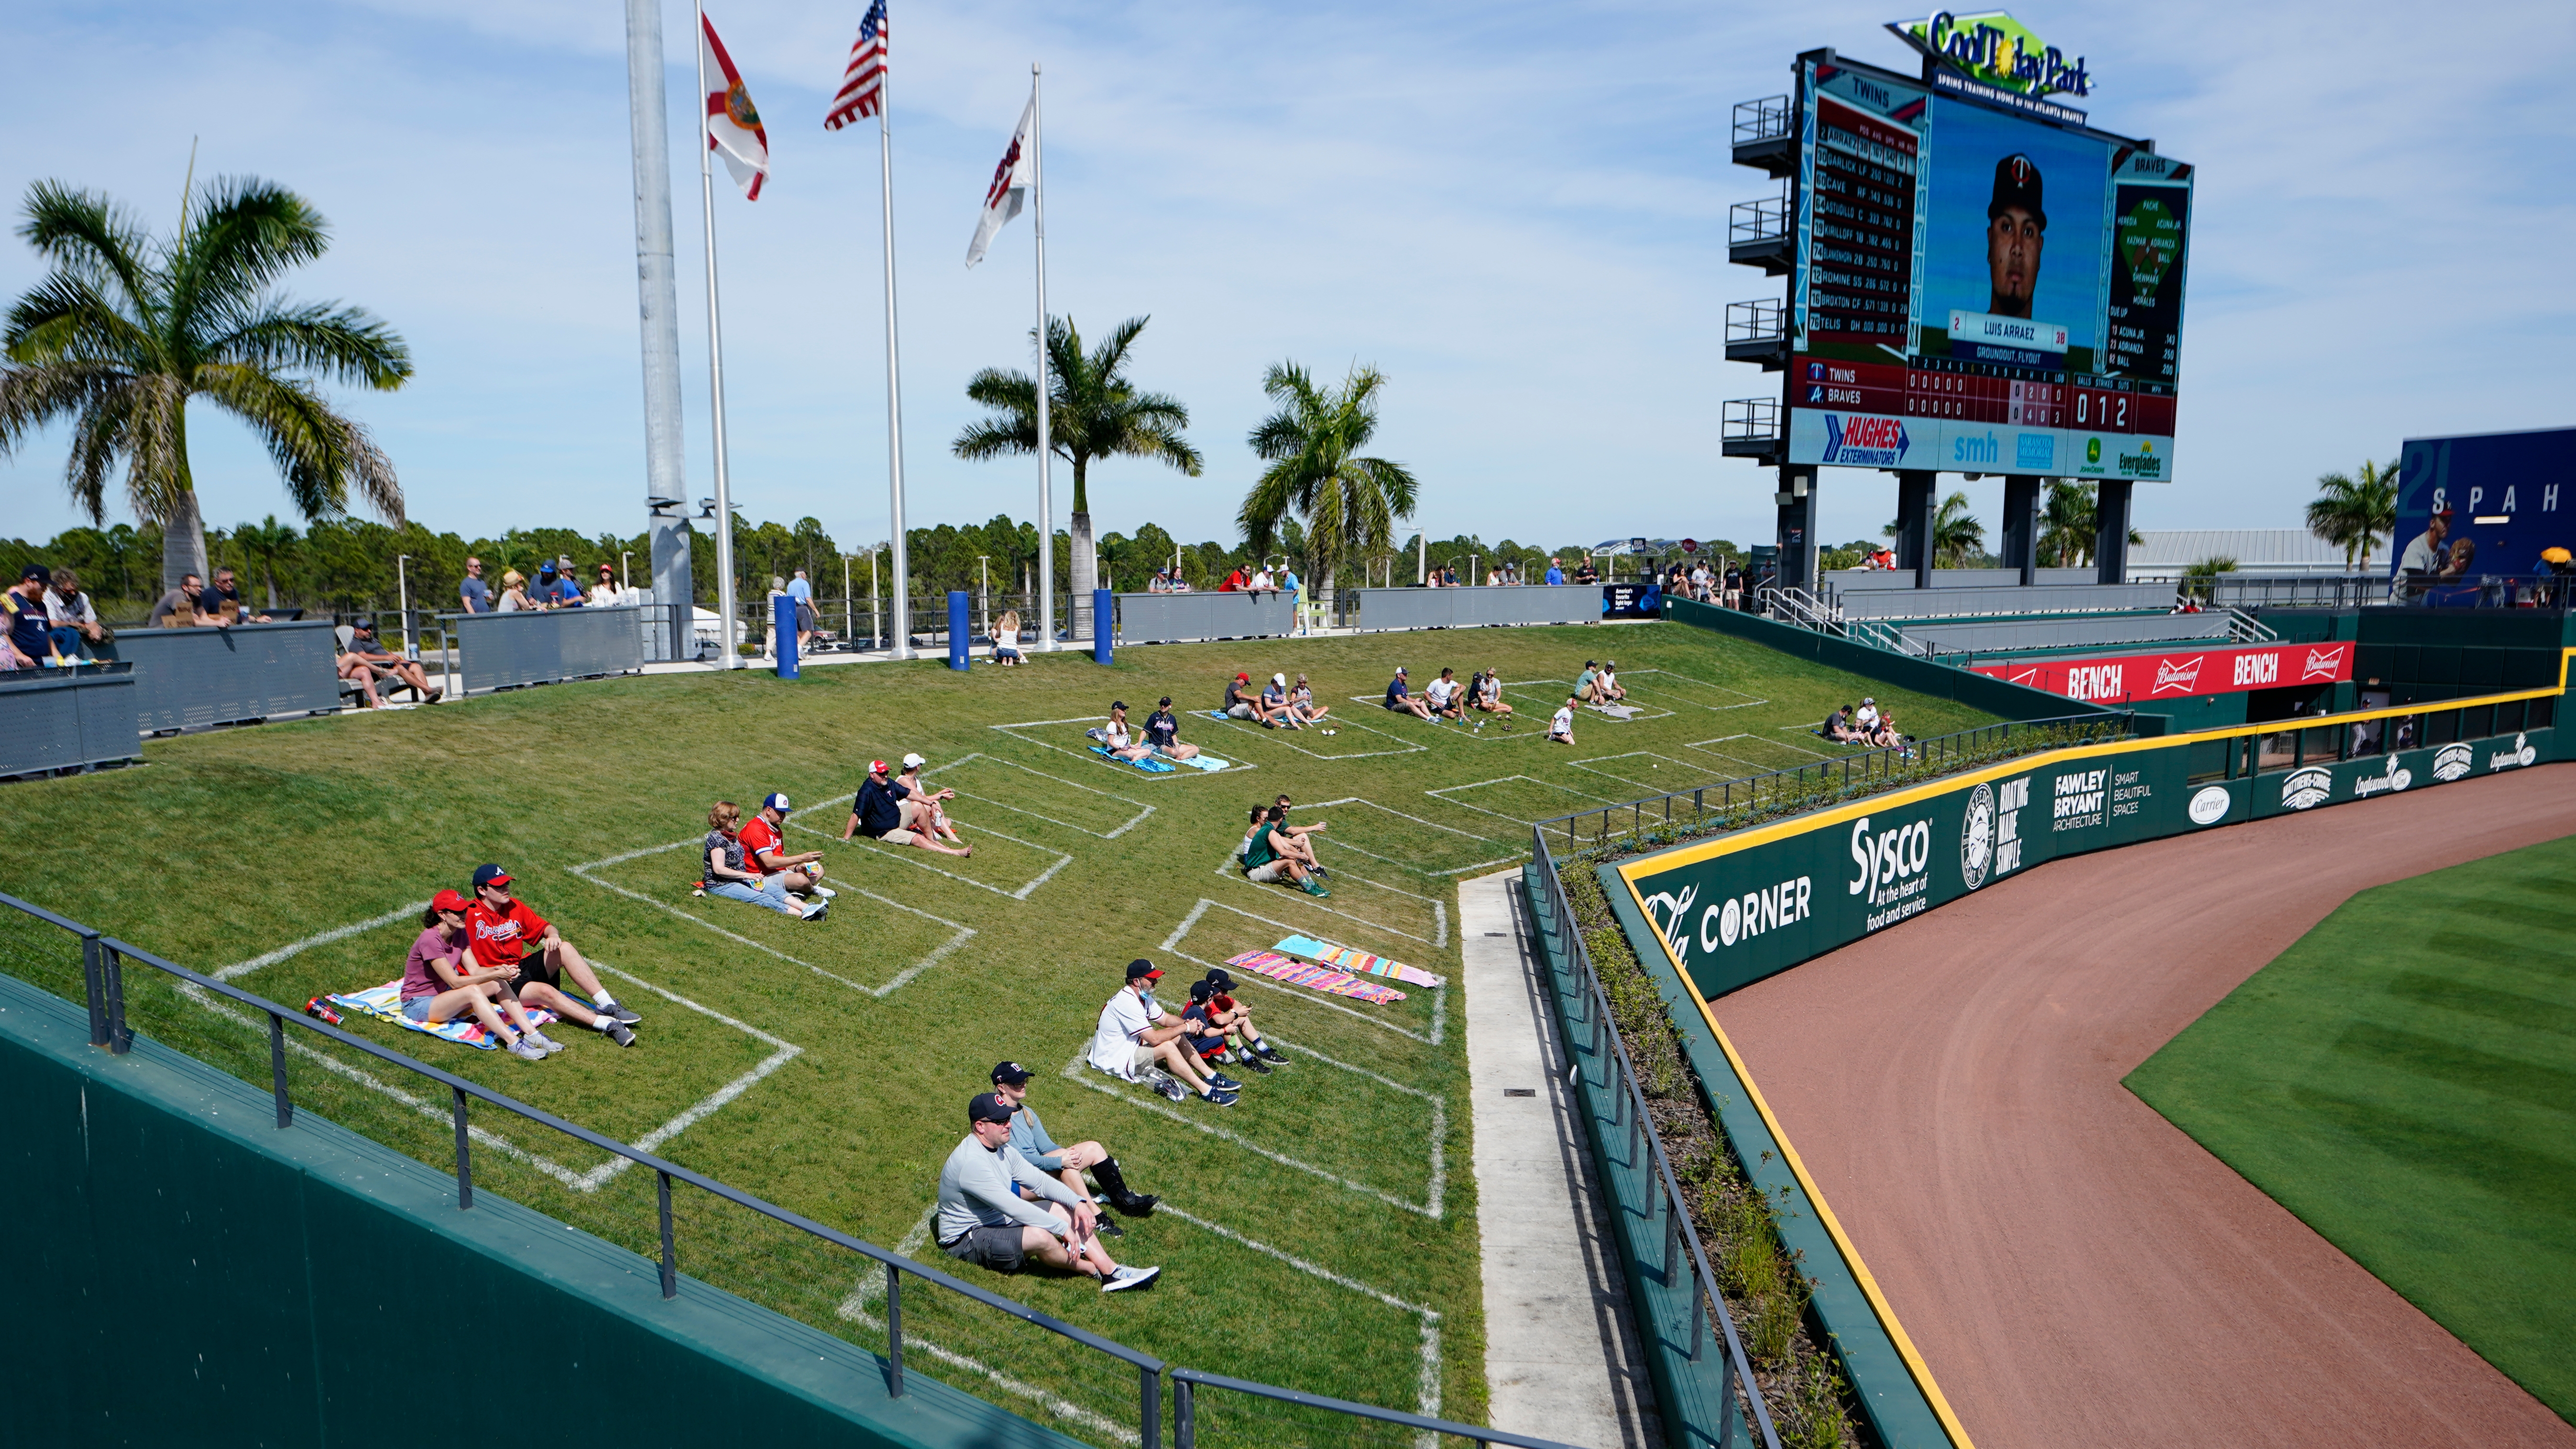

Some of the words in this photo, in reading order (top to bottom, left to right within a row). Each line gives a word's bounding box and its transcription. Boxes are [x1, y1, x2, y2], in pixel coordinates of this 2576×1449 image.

[2040, 43, 2089, 98] Park
[1853, 76, 1889, 109] TWINS
[1938, 73, 1962, 90] SPRING
[1964, 80, 1994, 99] TRAINING
[1996, 89, 2014, 105] HOME
[2016, 97, 2023, 108] OF
[2024, 99, 2034, 110] THE
[2035, 101, 2061, 118] ATLANTA
[2062, 109, 2083, 124] BRAVES
[1828, 128, 1857, 150] ARRAEZ
[1828, 153, 1856, 174] GARLICK
[2135, 156, 2166, 173] BRAVES
[1827, 176, 1846, 194] CAVE
[1826, 200, 1854, 219] ASTUDILLO
[1859, 209, 1863, 221] C
[1896, 219, 1901, 231] 0
[2143, 199, 2159, 212] PACHE
[2117, 215, 2137, 227] HEREDIA
[2156, 219, 2173, 231] ACUNA
[1825, 223, 1853, 241] KIRILLOFF
[1895, 240, 1899, 252] 0
[2127, 235, 2147, 247] KAZMAR
[2150, 237, 2175, 250] ADRIANZA
[1894, 260, 1898, 272] 0
[2158, 252, 2170, 263] BALL
[1823, 270, 1851, 286] ROMINE
[1853, 275, 1862, 288] SS
[1893, 281, 1897, 293] 0
[1903, 283, 1907, 294] K
[2132, 272, 2159, 285] SHEWMAKE
[1821, 294, 1850, 308] BROXTON
[1852, 297, 1861, 309] CF
[1892, 302, 1896, 314] 0
[2133, 295, 2156, 307] MORALES
[2110, 305, 2120, 318] DUE
[2120, 307, 2128, 318] UP
[1821, 317, 1841, 330] TELIS
[1851, 319, 1860, 332] DH
[1862, 320, 1874, 332] .000
[1875, 321, 1887, 333] .000
[1891, 323, 1895, 334] 0
[1954, 317, 1960, 330] 2
[1984, 321, 2002, 336] LUIS
[2004, 325, 2035, 341] ARRAEZ
[2112, 324, 2117, 336] 13
[2119, 326, 2136, 339] ACUNA
[2056, 331, 2065, 344] 3B
[1977, 346, 2017, 363] GROUNDOUT,
[2018, 351, 2041, 365] FLYOUT
[2110, 339, 2116, 350] 23
[2117, 340, 2144, 355] ADRIANZA
[2162, 348, 2174, 361] .250
[1913, 357, 1916, 367] 1
[1924, 358, 1928, 369] 2
[1936, 359, 1940, 370] 3
[1948, 361, 1951, 371] 4
[1983, 364, 1986, 375] 7
[2117, 354, 2129, 368] BALL
[2161, 363, 2173, 376] .200
[1830, 367, 1855, 384] TWINS
[1910, 373, 1916, 387] 0
[1922, 375, 1928, 389] 0
[1934, 376, 1940, 390] 0
[1946, 377, 1951, 391] 0
[1958, 379, 1963, 392] 0
[2015, 384, 2020, 397] 0
[2028, 386, 2034, 399] 2
[2042, 387, 2047, 400] 0
[2057, 389, 2061, 401] 0
[2078, 375, 2091, 386] BALLS
[2095, 378, 2113, 389] STRIKES
[2118, 380, 2129, 390] OUTS
[2152, 384, 2161, 394] MPH
[1828, 388, 1861, 405] BRAVES
[1909, 398, 1914, 412] 0
[1921, 399, 1927, 413] 0
[1933, 400, 1939, 414] 0
[1945, 401, 1950, 415] 0
[1956, 402, 1962, 415] 0
[2014, 407, 2018, 419] 0
[2027, 409, 2032, 421] 4
[2040, 410, 2045, 422] 0
[2055, 411, 2060, 424] 3
[2077, 393, 2087, 423] 0
[2099, 395, 2106, 425] 1
[2116, 397, 2127, 426] 2
[1843, 416, 1901, 449] HUGHES
[2020, 436, 2051, 448] SARASOTA
[1954, 431, 1998, 462] smh
[2019, 446, 2051, 459] MEMORIAL
[1840, 448, 1896, 466] EXTERMINATORS
[2119, 452, 2161, 475] Everglades
[2397, 440, 2452, 518] 21
[2234, 653, 2279, 686] BENCH
[2307, 656, 2339, 671] Budweiser
[2068, 664, 2122, 700] BENCH
[2158, 667, 2198, 684] Budweiser
[2055, 769, 2106, 796] FAWLEY
[2115, 771, 2139, 786] SMART
[2282, 773, 2331, 800] MATTHEWS-CURRIE
[2355, 775, 2390, 798] Englewood
[1999, 777, 2029, 814] BOATING
[2114, 785, 2152, 801] BEAUTIFUL
[2298, 792, 2313, 806] Ford
[1967, 790, 1992, 823] FREEDOM
[2054, 791, 2104, 818] BRYANT
[2113, 801, 2139, 817] SPACES
[2195, 798, 2225, 814] Carrier
[1997, 810, 2018, 845] MADE
[2052, 812, 2103, 833] ARCHITECTURE
[1964, 856, 1976, 883] BOAT
[1978, 847, 1990, 878] CLUB
[1996, 838, 2022, 876] SIMPLE
[495, 867, 504, 875] A
[1876, 889, 1886, 908] At
[1886, 885, 1898, 903] the
[1899, 878, 1919, 899] heart
[1920, 871, 1929, 890] of
[1700, 876, 1811, 953] CORNER
[1867, 908, 1885, 932] food
[1885, 902, 1900, 924] and
[1901, 895, 1926, 918] service
[476, 919, 514, 941] Braves
